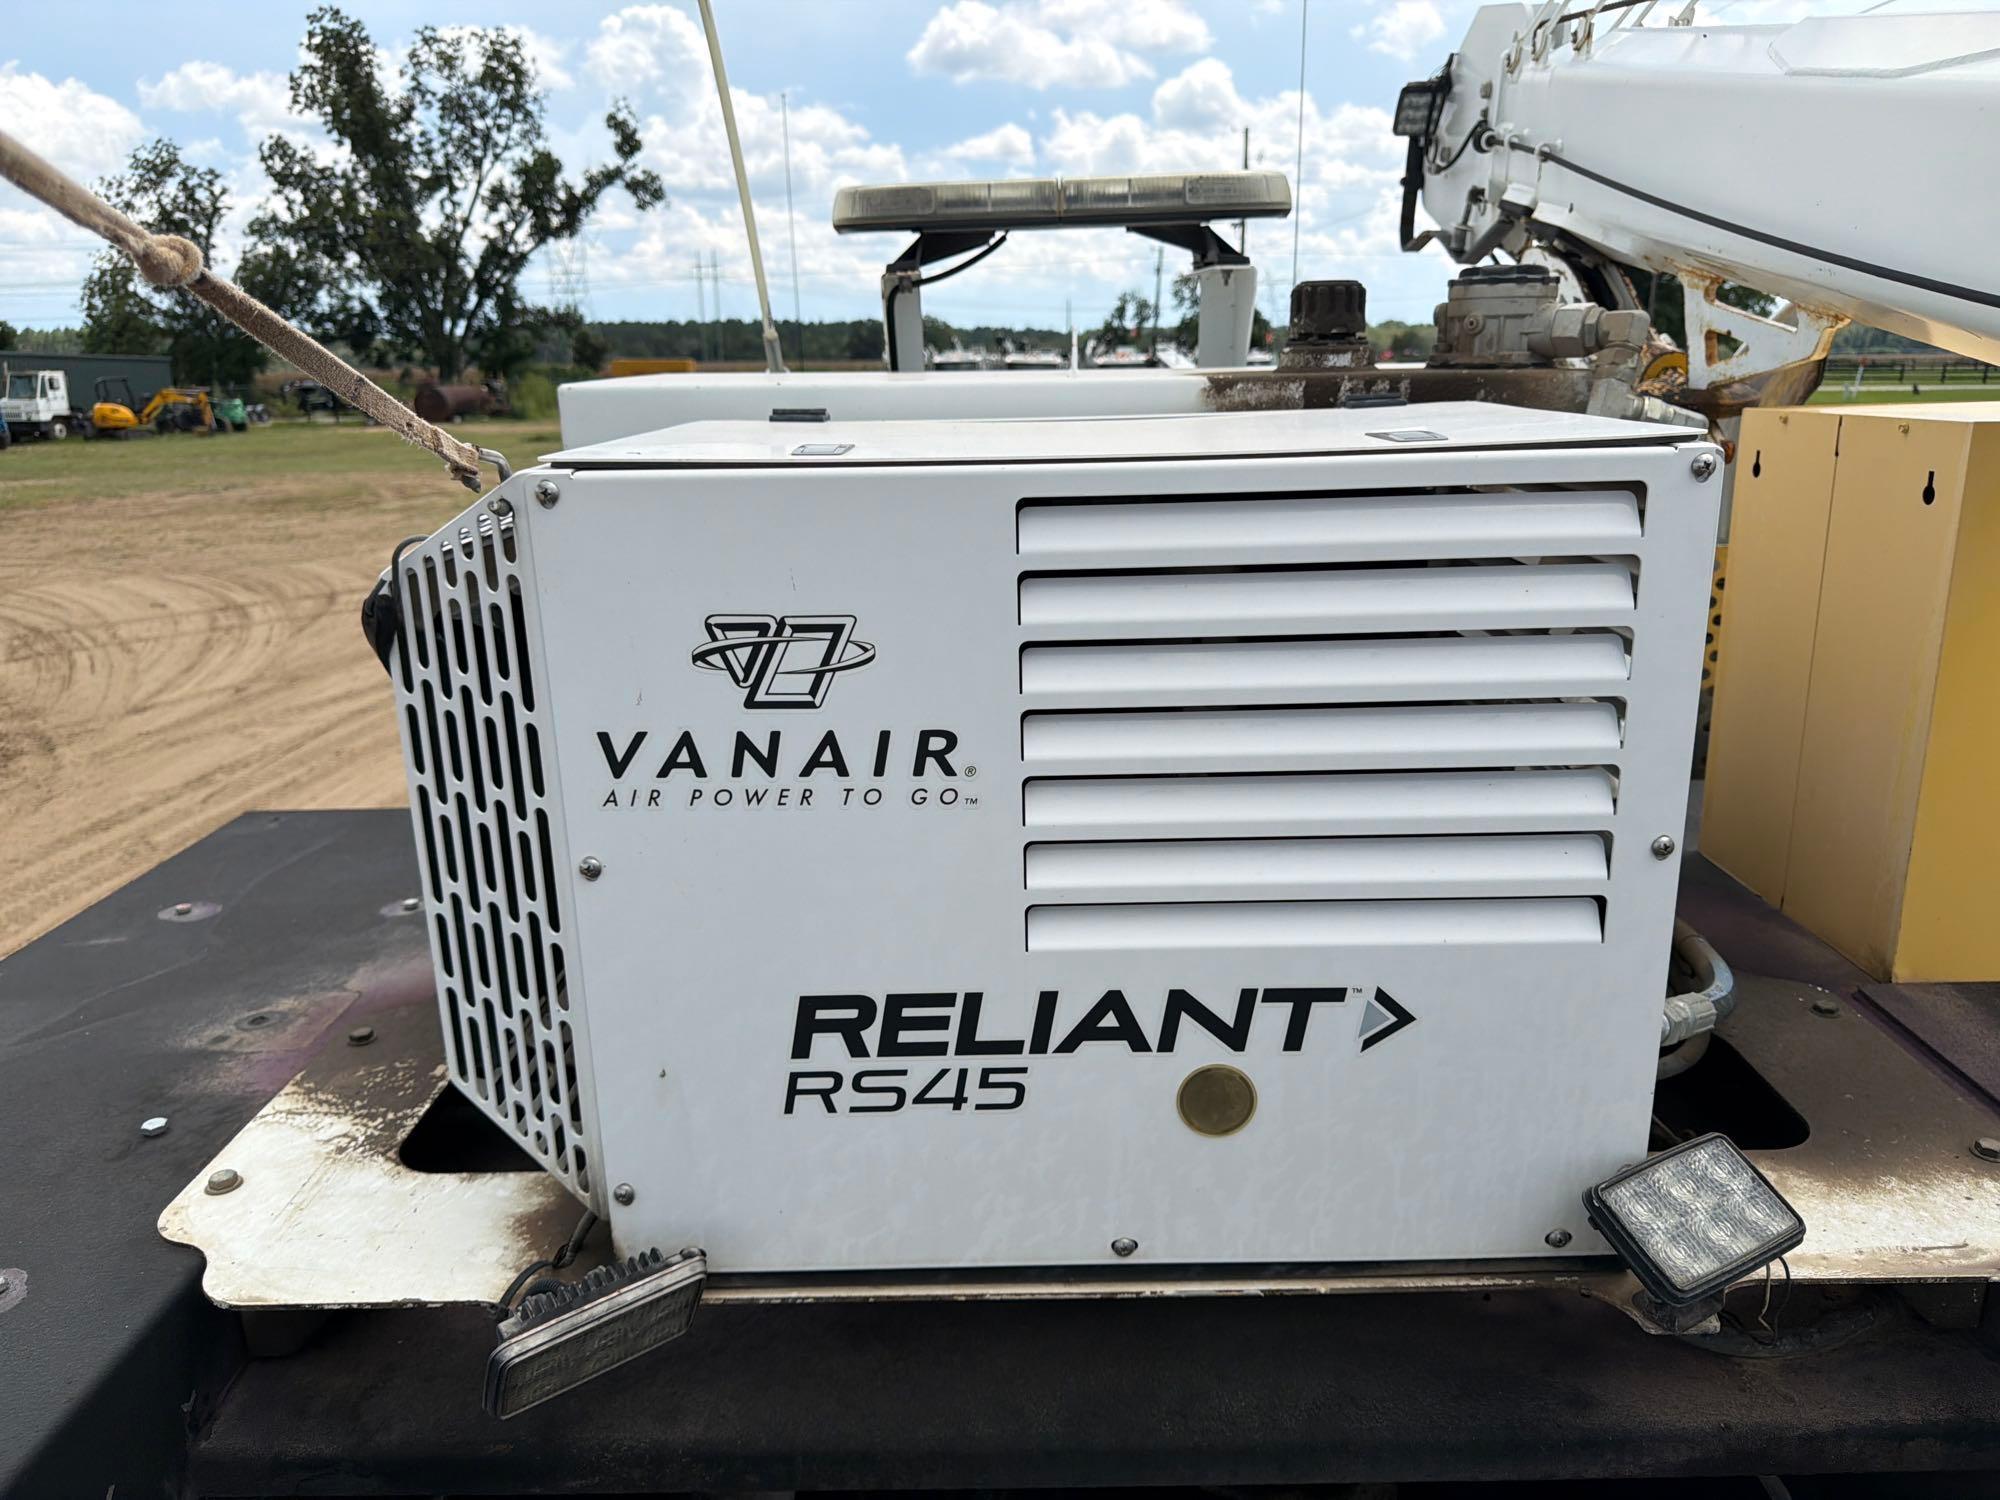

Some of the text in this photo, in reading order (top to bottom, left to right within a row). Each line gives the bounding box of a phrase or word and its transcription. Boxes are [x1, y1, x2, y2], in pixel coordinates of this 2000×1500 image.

[596, 729, 958, 780] VANAIR
[602, 788, 662, 807] AIR
[689, 788, 813, 807] POWER
[842, 788, 883, 806] TO
[790, 986, 1349, 1060] RELIANT
[783, 1066, 1029, 1115] RS45
